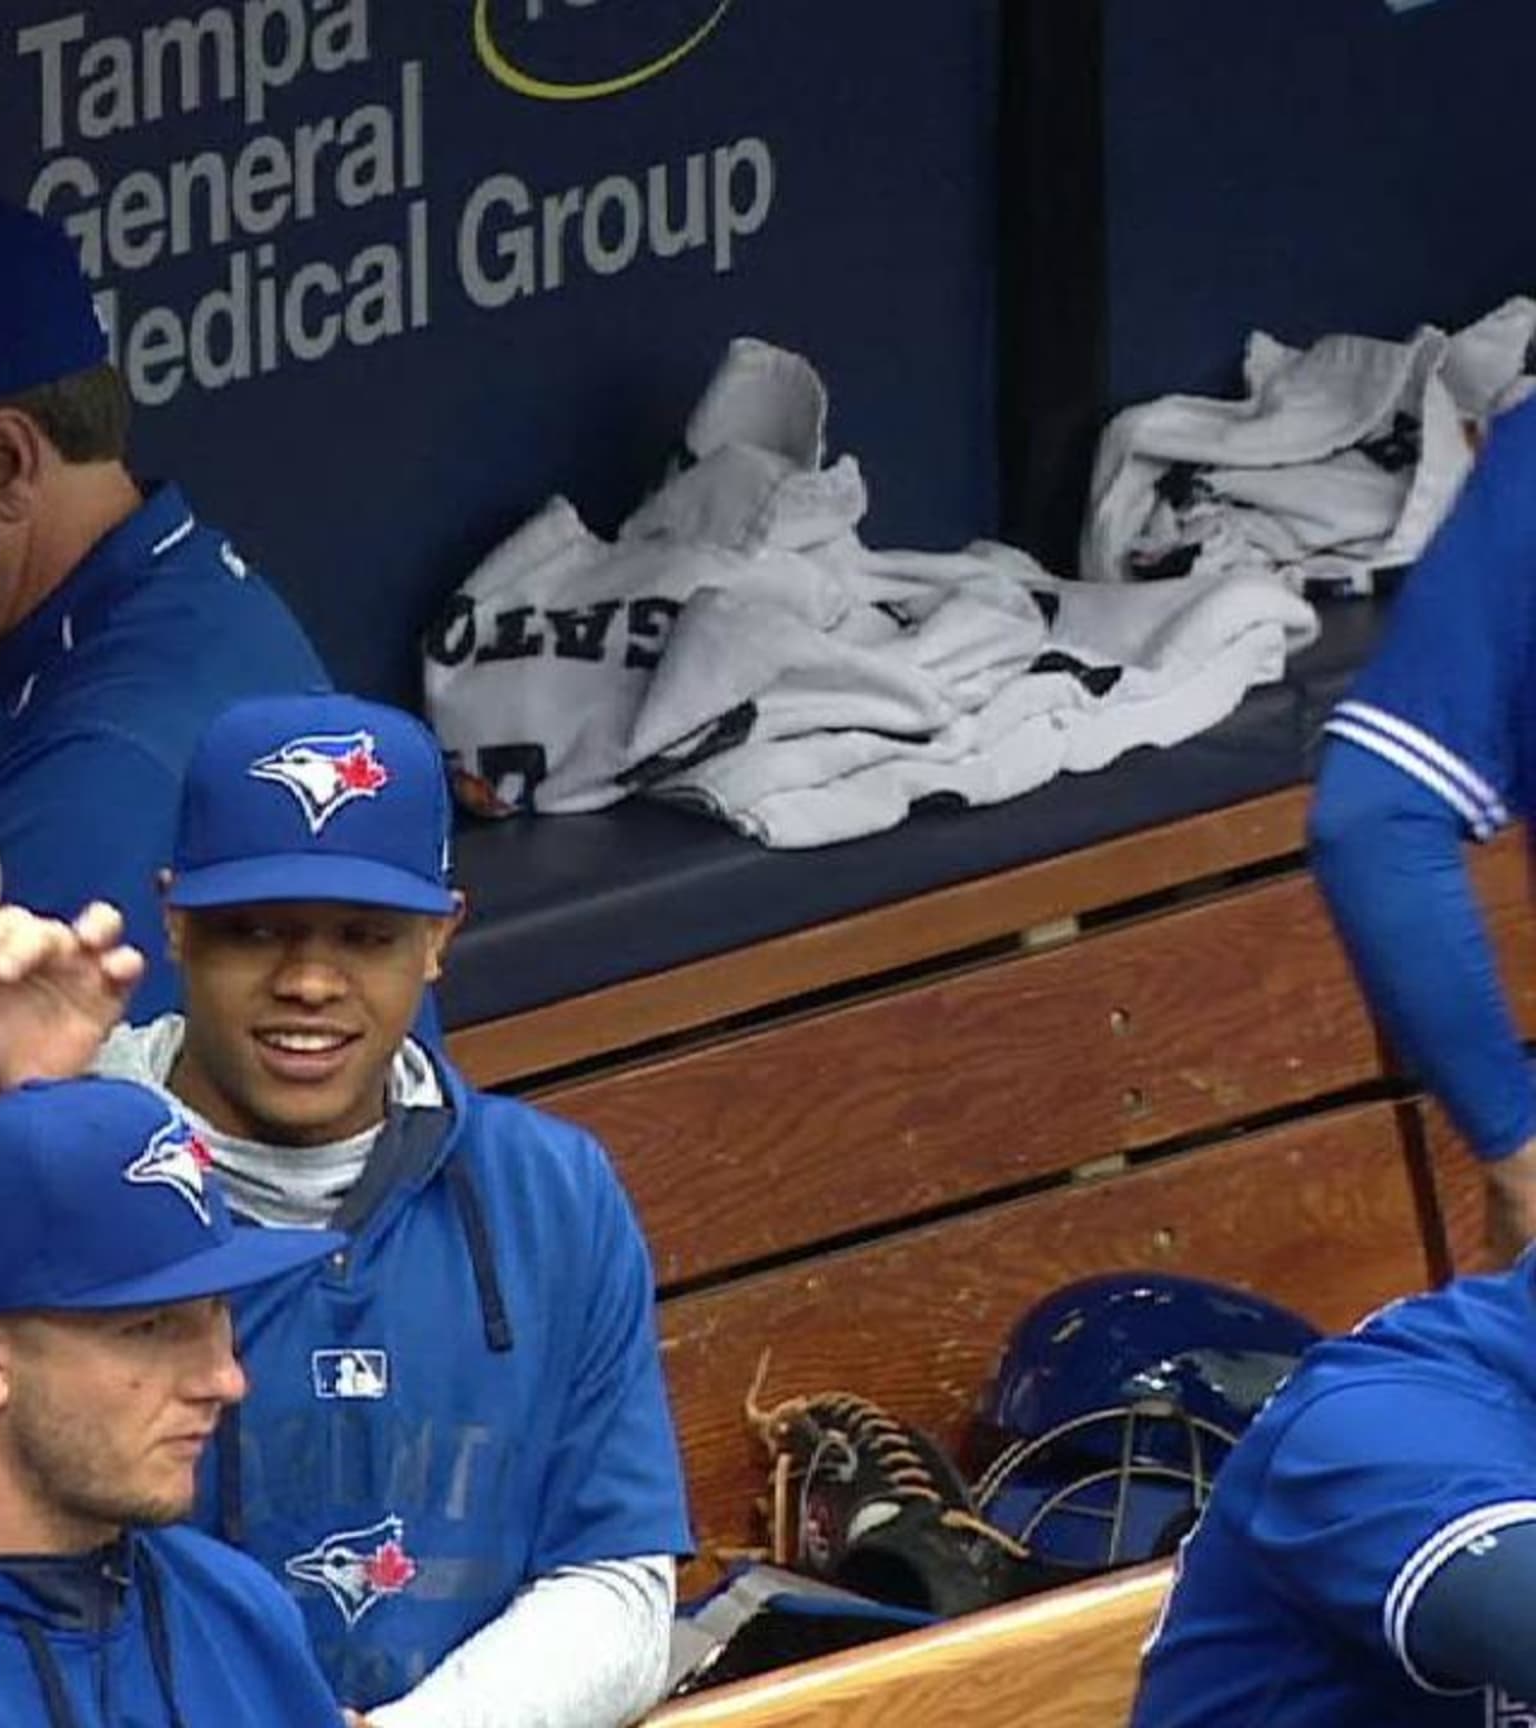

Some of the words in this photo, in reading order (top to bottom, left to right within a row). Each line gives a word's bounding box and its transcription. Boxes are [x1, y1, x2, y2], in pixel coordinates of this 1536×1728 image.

[17, 0, 369, 149] Tampa
[28, 62, 424, 278] General
[457, 136, 776, 310] Group
